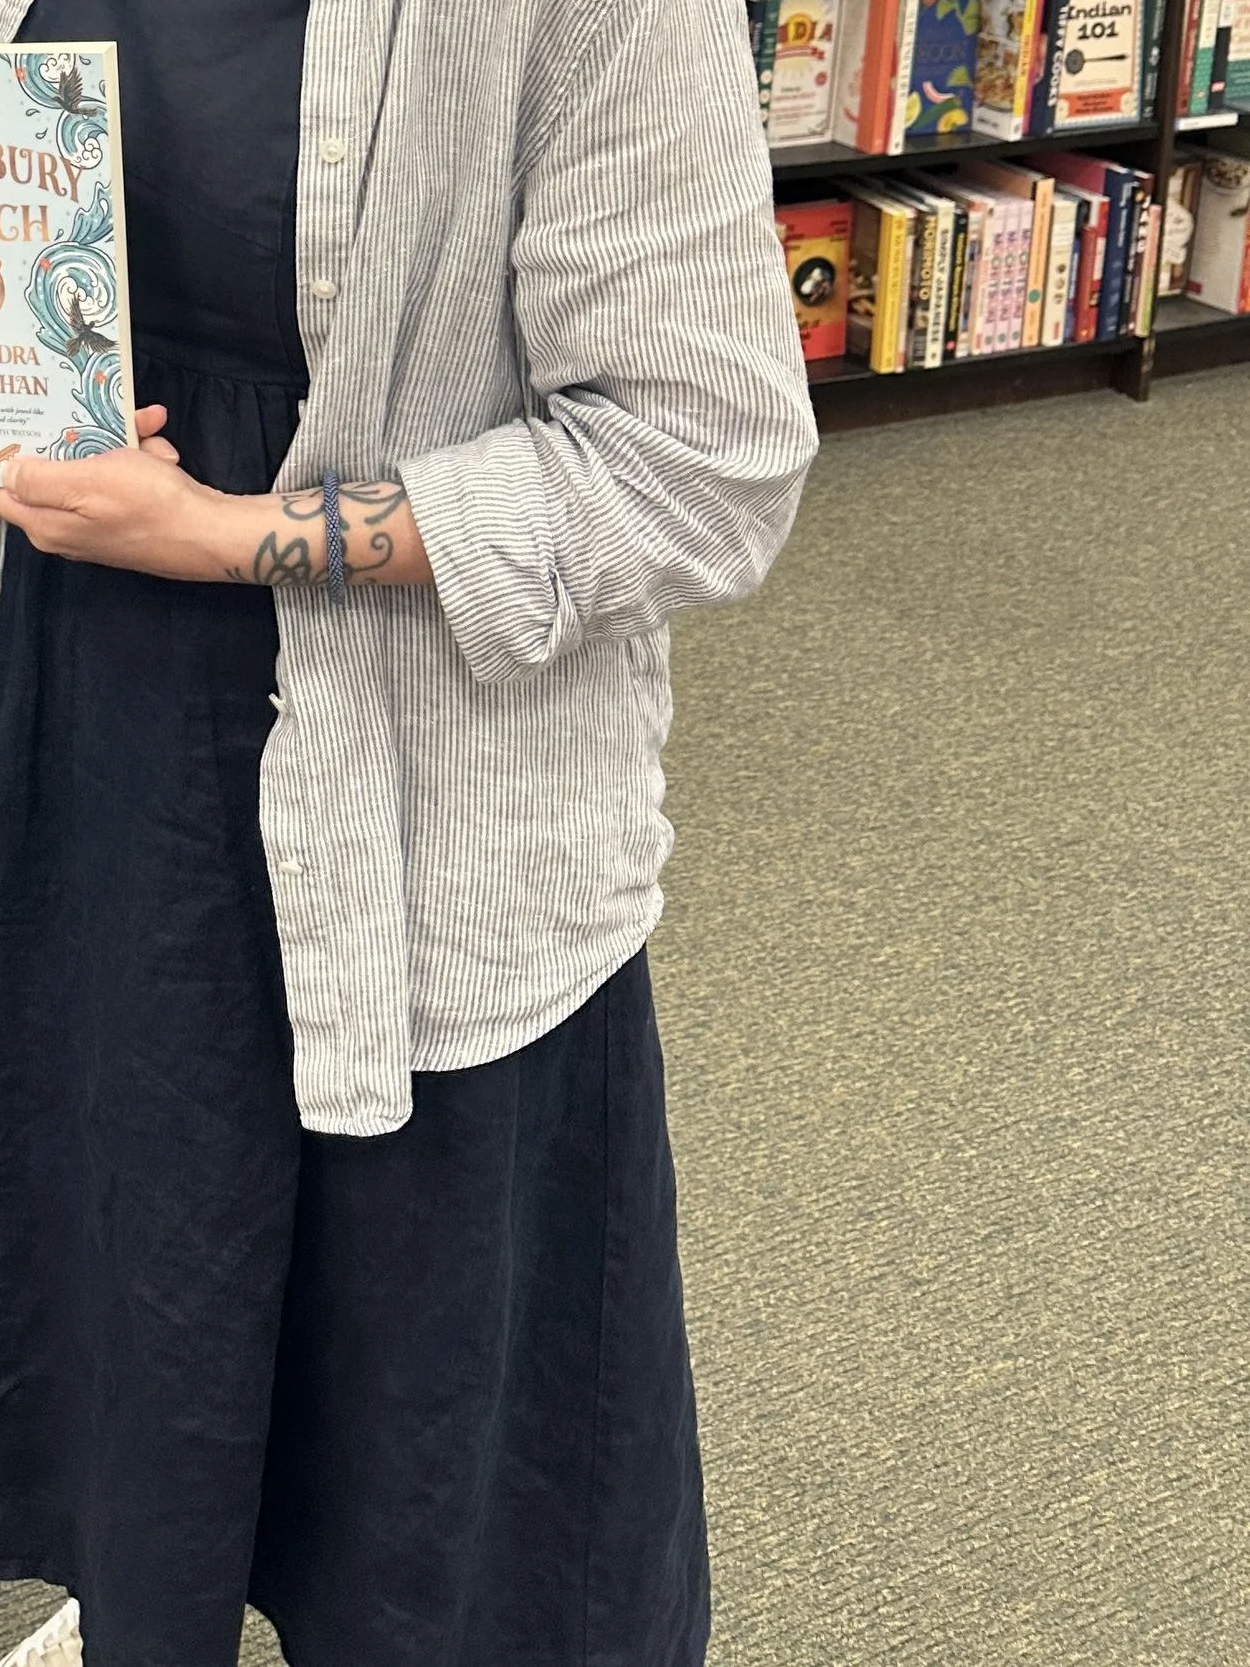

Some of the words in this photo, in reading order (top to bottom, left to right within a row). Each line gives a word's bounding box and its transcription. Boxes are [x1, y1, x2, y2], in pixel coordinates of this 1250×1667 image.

[1068, 2, 1131, 20] Indian
[1077, 21, 1119, 41] 101
[1048, 53, 1062, 107] COOKS
[919, 216, 937, 301] MORIMOTO
[936, 228, 949, 273] SIMPLY
[929, 278, 944, 345] JAPANESE
